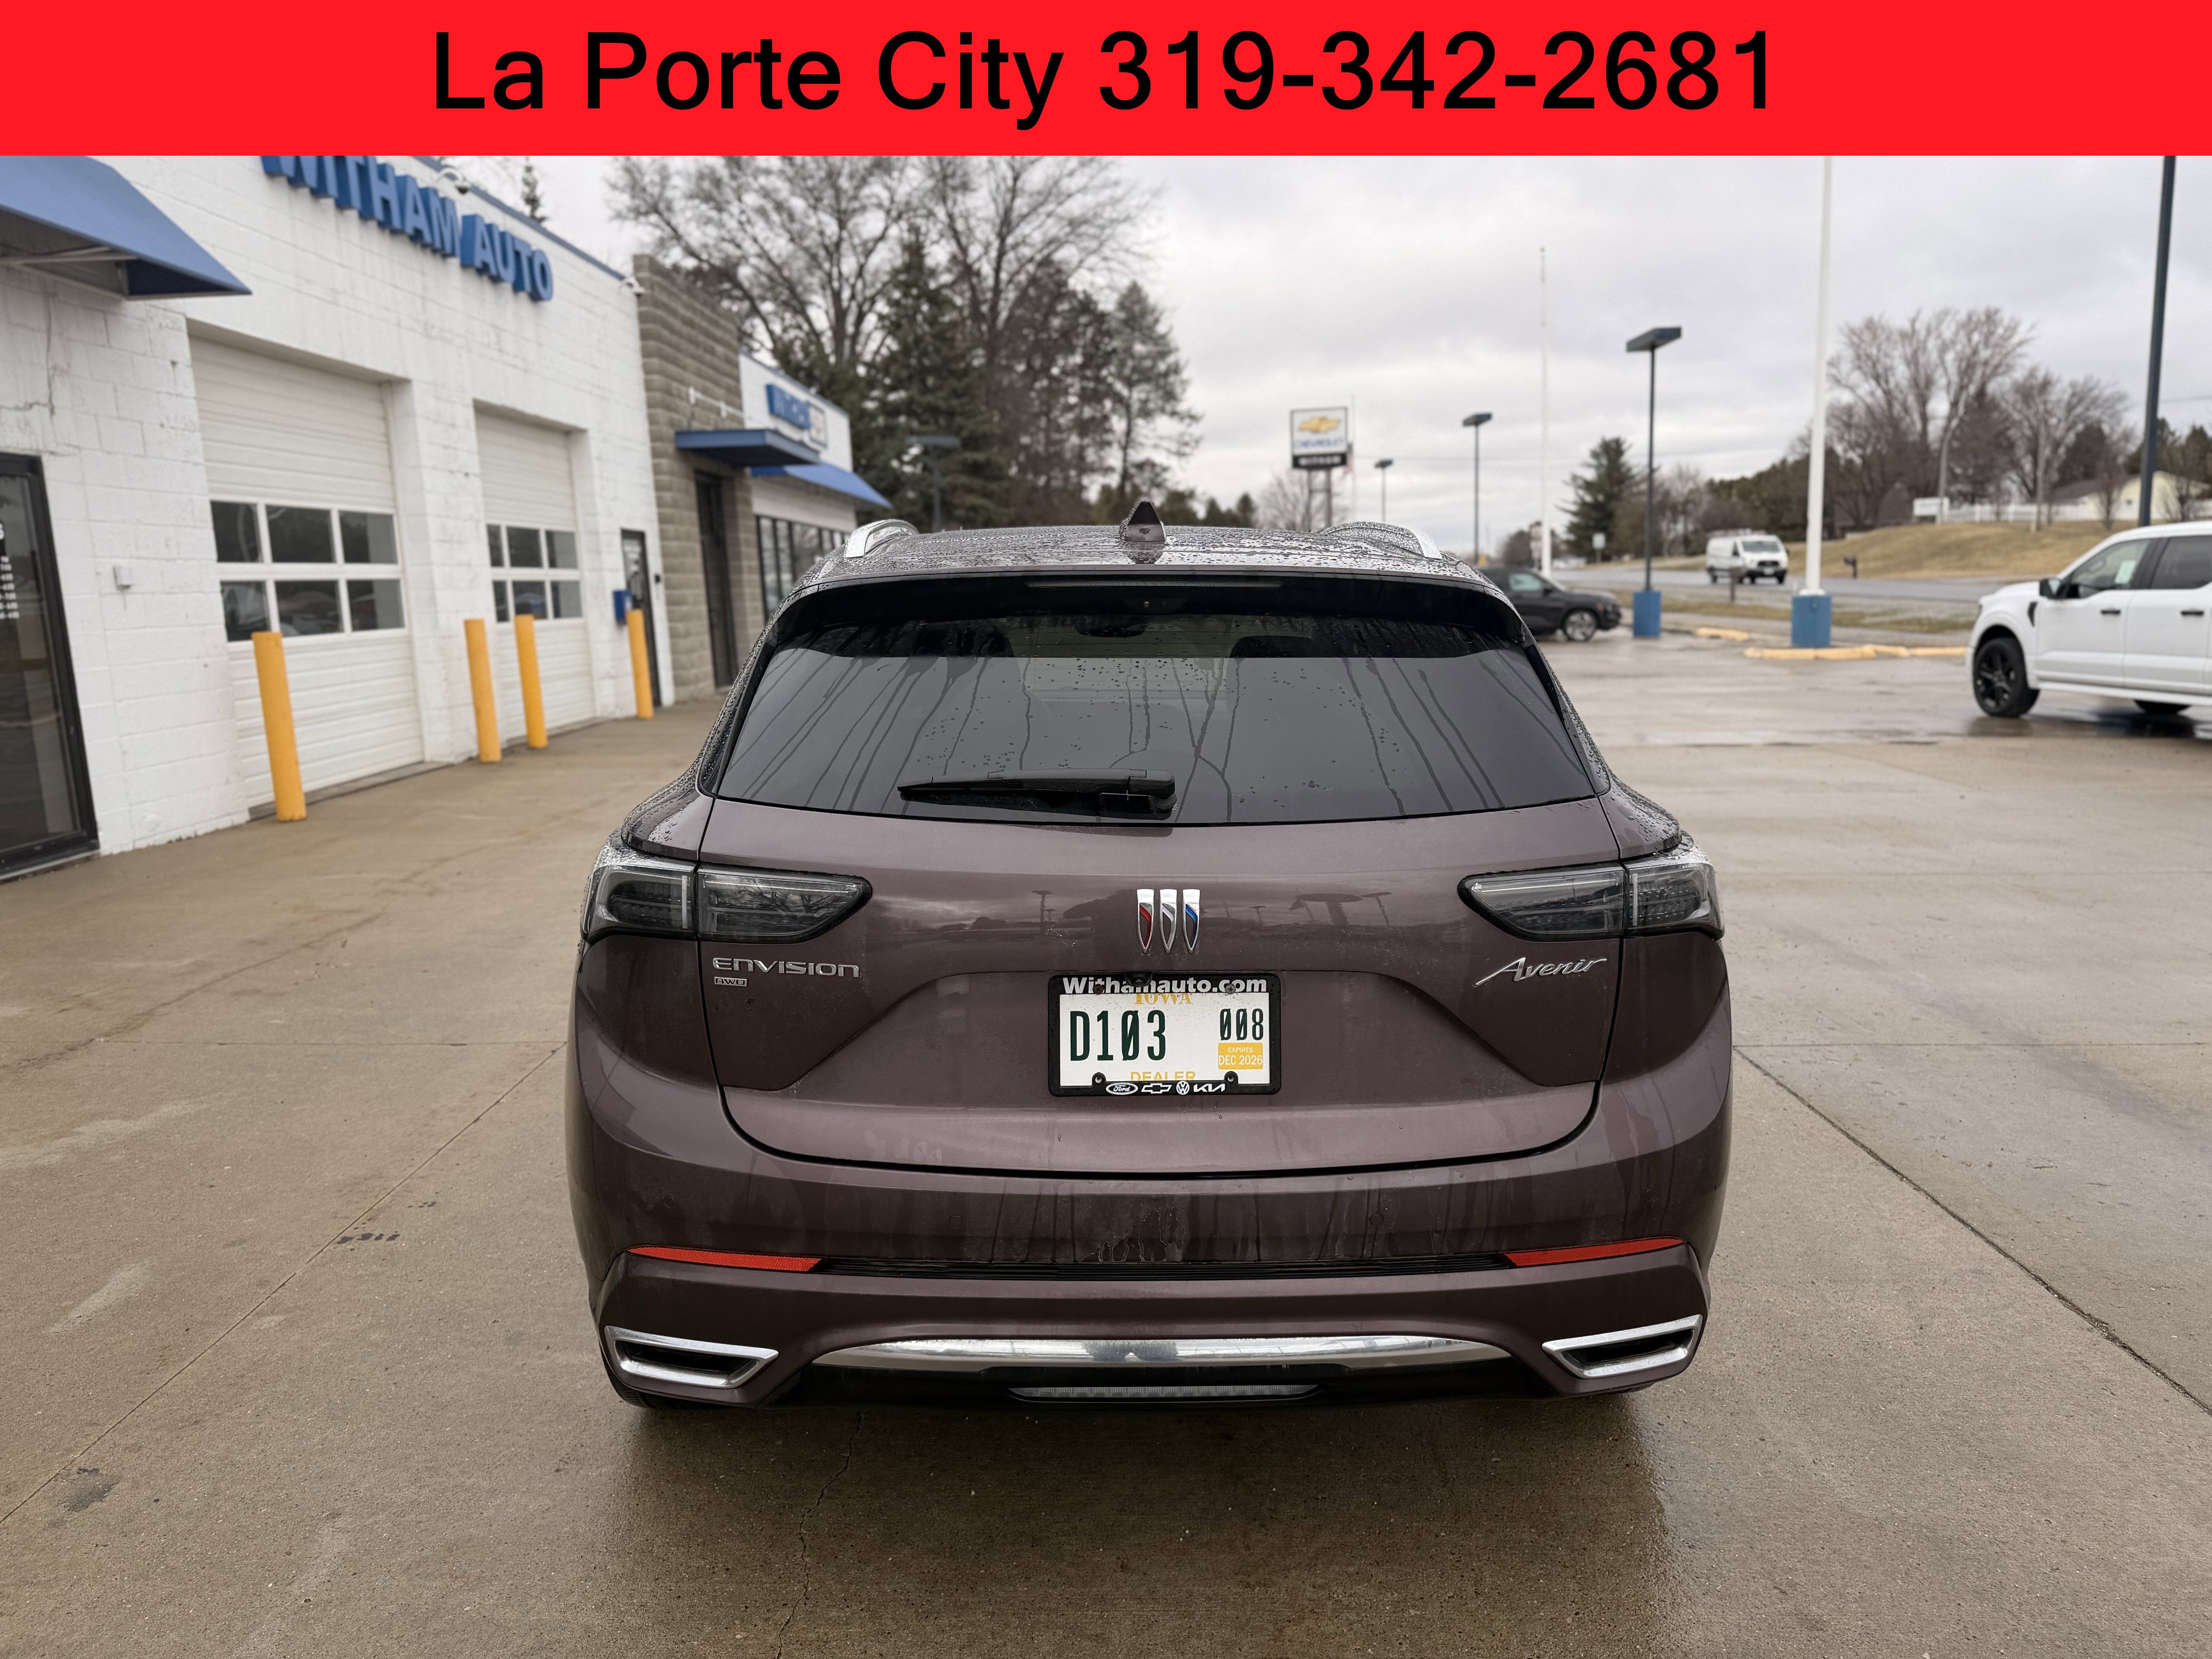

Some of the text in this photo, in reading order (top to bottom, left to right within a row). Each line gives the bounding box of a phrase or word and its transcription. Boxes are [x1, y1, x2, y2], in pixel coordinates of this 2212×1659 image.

[461, 214, 552, 302] AUTO
[713, 957, 860, 978] ENVISION
[1473, 957, 1607, 987] Avenir
[1070, 1008, 1264, 1061] D103 008
[1219, 1055, 1263, 1065] DEC 2026
